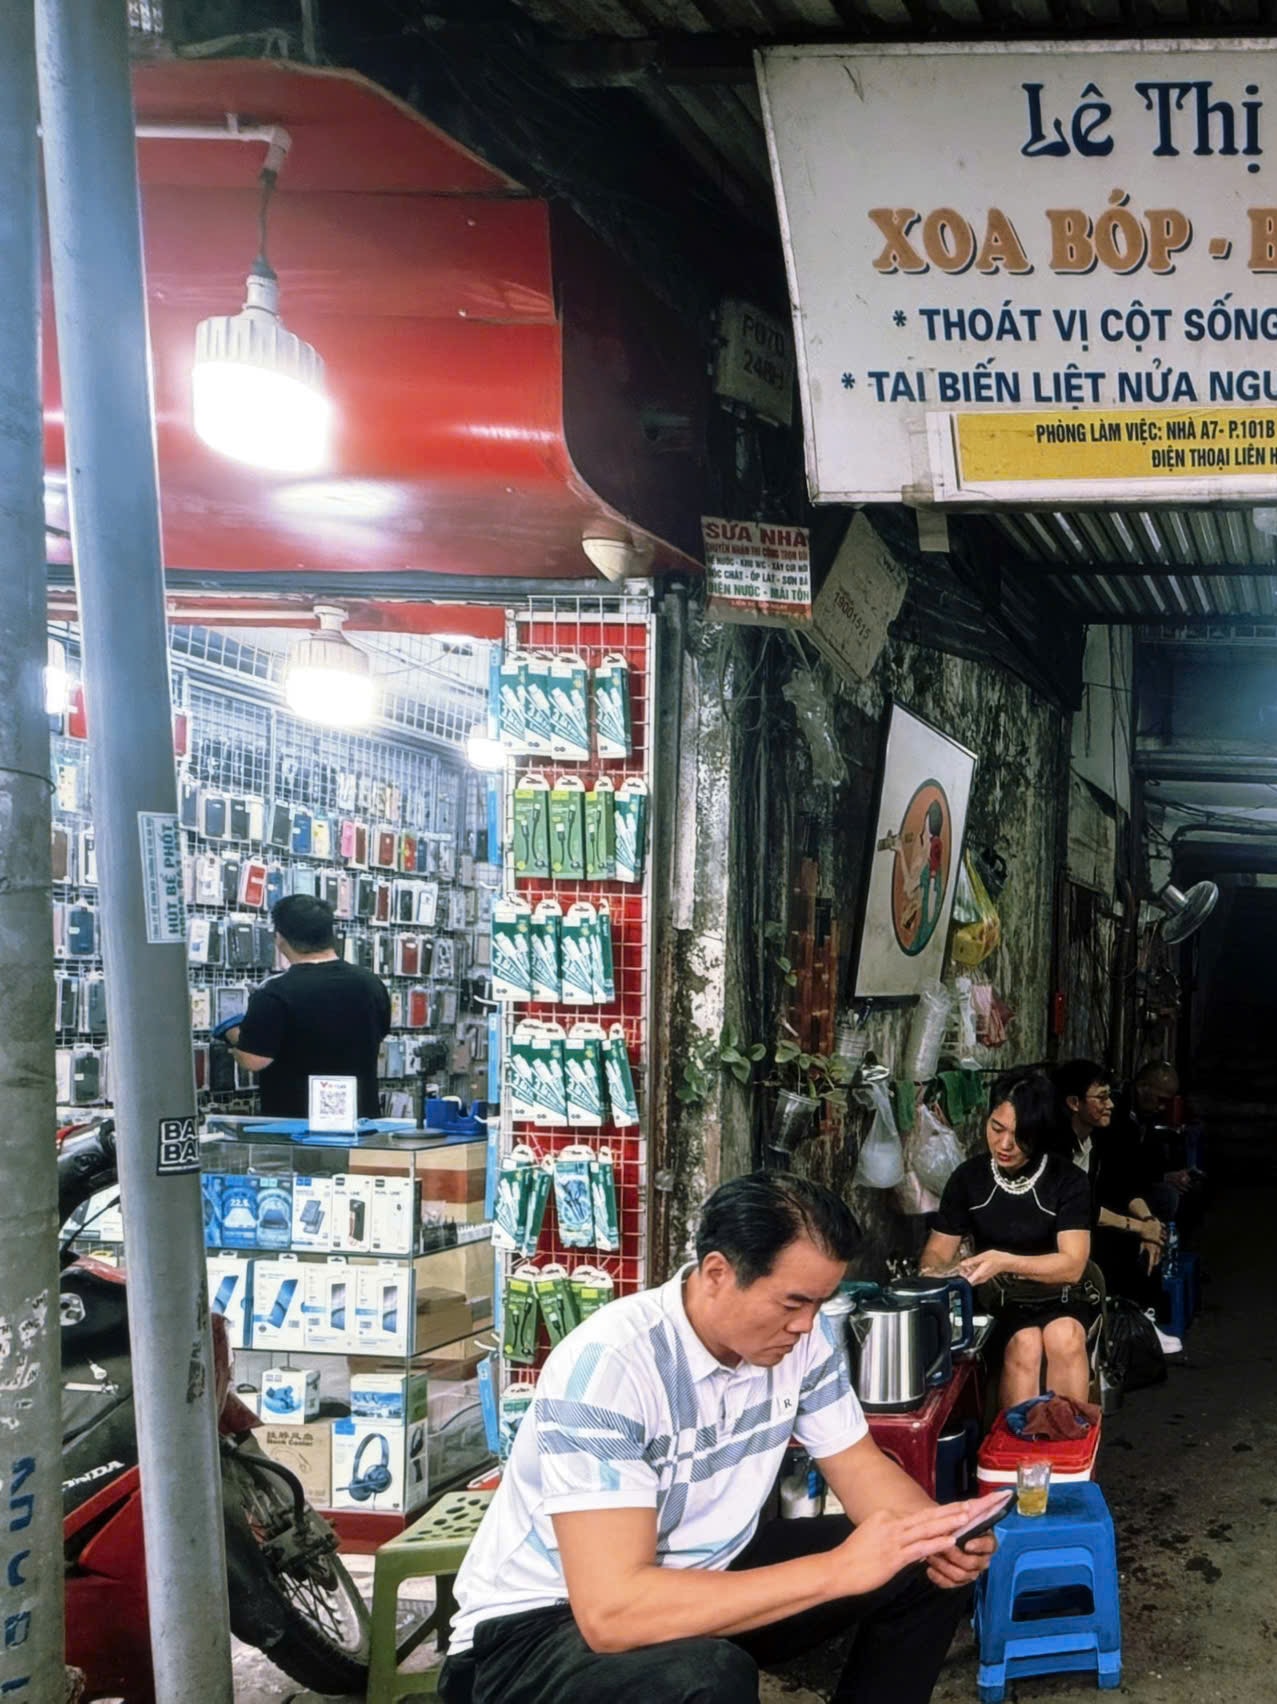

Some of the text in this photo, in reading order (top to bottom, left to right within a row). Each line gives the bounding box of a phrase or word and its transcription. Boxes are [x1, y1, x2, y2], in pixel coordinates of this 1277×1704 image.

[1020, 81, 1115, 157] Lê
[1137, 81, 1262, 173] Thị
[868, 207, 1034, 277] XOA
[1046, 188, 1194, 277] BÓP
[920, 299, 1042, 343] THOÁT
[1053, 310, 1090, 354] VỊ
[1099, 301, 1174, 353] CỘT
[867, 371, 926, 402] TAI
[938, 357, 1020, 402] BIẾN
[1033, 364, 1106, 411] LIỆT
[1118, 358, 1198, 402] NỬA
[1036, 418, 1087, 443] PHÒNG
[1090, 418, 1122, 442] LÀM
[1125, 418, 1162, 446] VIỆC:
[1166, 415, 1196, 441] NHÀ
[1228, 419, 1275, 440] P.101B
[1151, 446, 1185, 471] ĐIỆN
[1189, 447, 1231, 471] THOẠI
[1235, 444, 1266, 467] LIÊN
[161, 1118, 199, 1143] BA
[160, 1141, 200, 1165] BA
